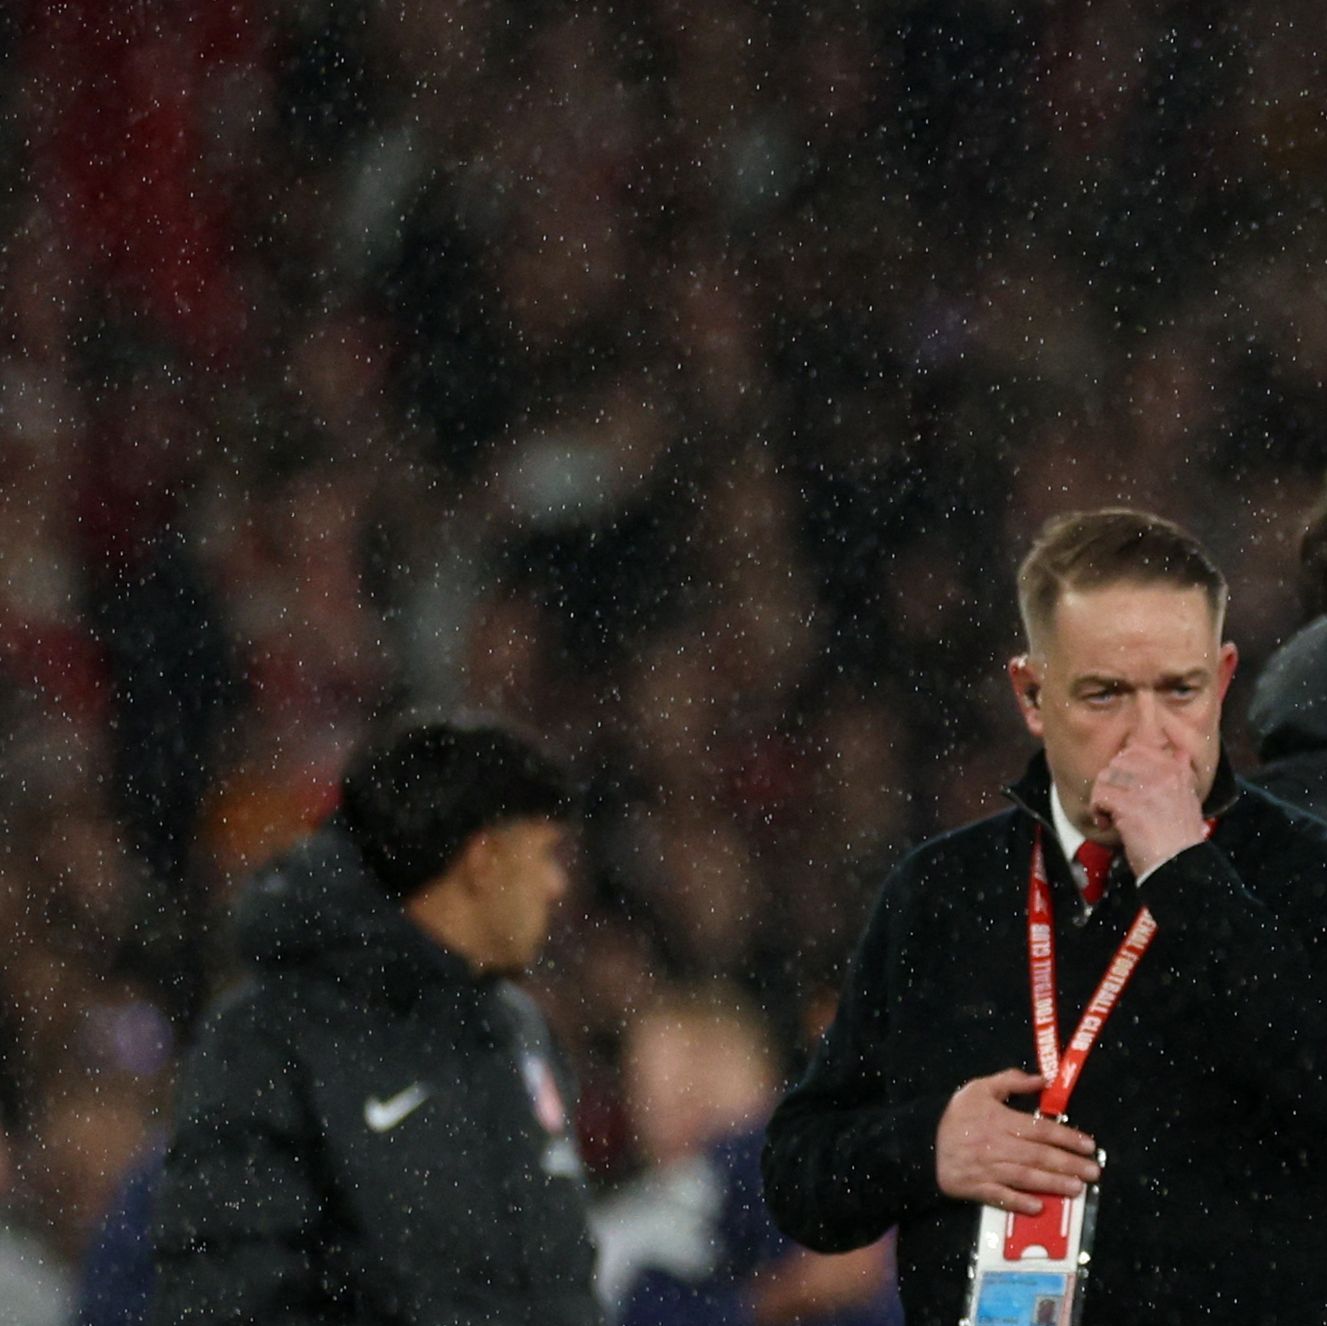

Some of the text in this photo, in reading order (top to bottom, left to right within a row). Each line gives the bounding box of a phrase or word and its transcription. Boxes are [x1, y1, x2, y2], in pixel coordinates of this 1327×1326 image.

[1029, 923, 1052, 957] CLUB
[1070, 1014, 1102, 1051] CLUB
[1036, 1025, 1059, 1088] RSENAL
